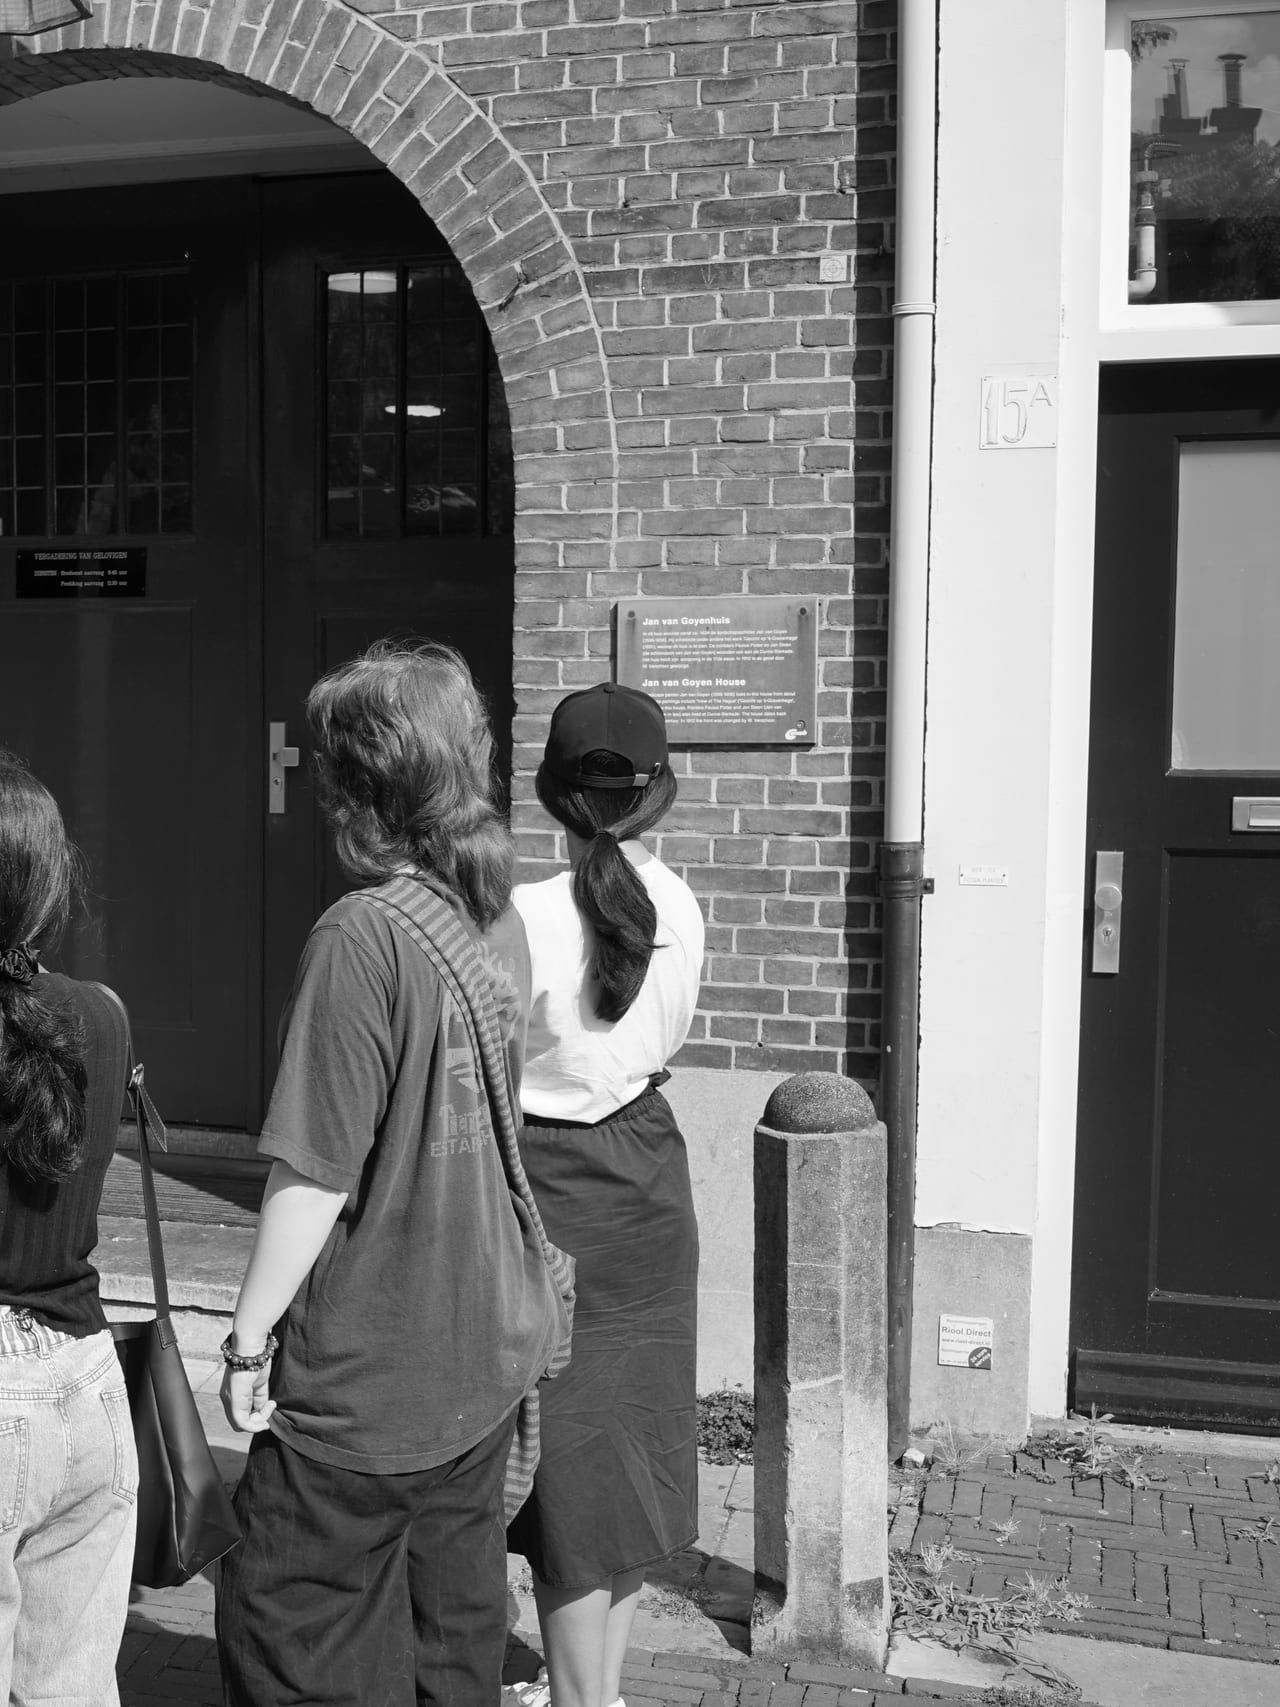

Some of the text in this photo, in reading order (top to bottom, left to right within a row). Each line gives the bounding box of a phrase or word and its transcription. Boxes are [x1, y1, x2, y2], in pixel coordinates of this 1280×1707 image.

[78, 551, 91, 560] VAN
[642, 616, 730, 627] Jan van Goyenhuis
[642, 679, 659, 687] Jan
[682, 678, 712, 688] Goyen
[715, 678, 746, 687] House
[941, 1326, 991, 1337] Riool Direct
